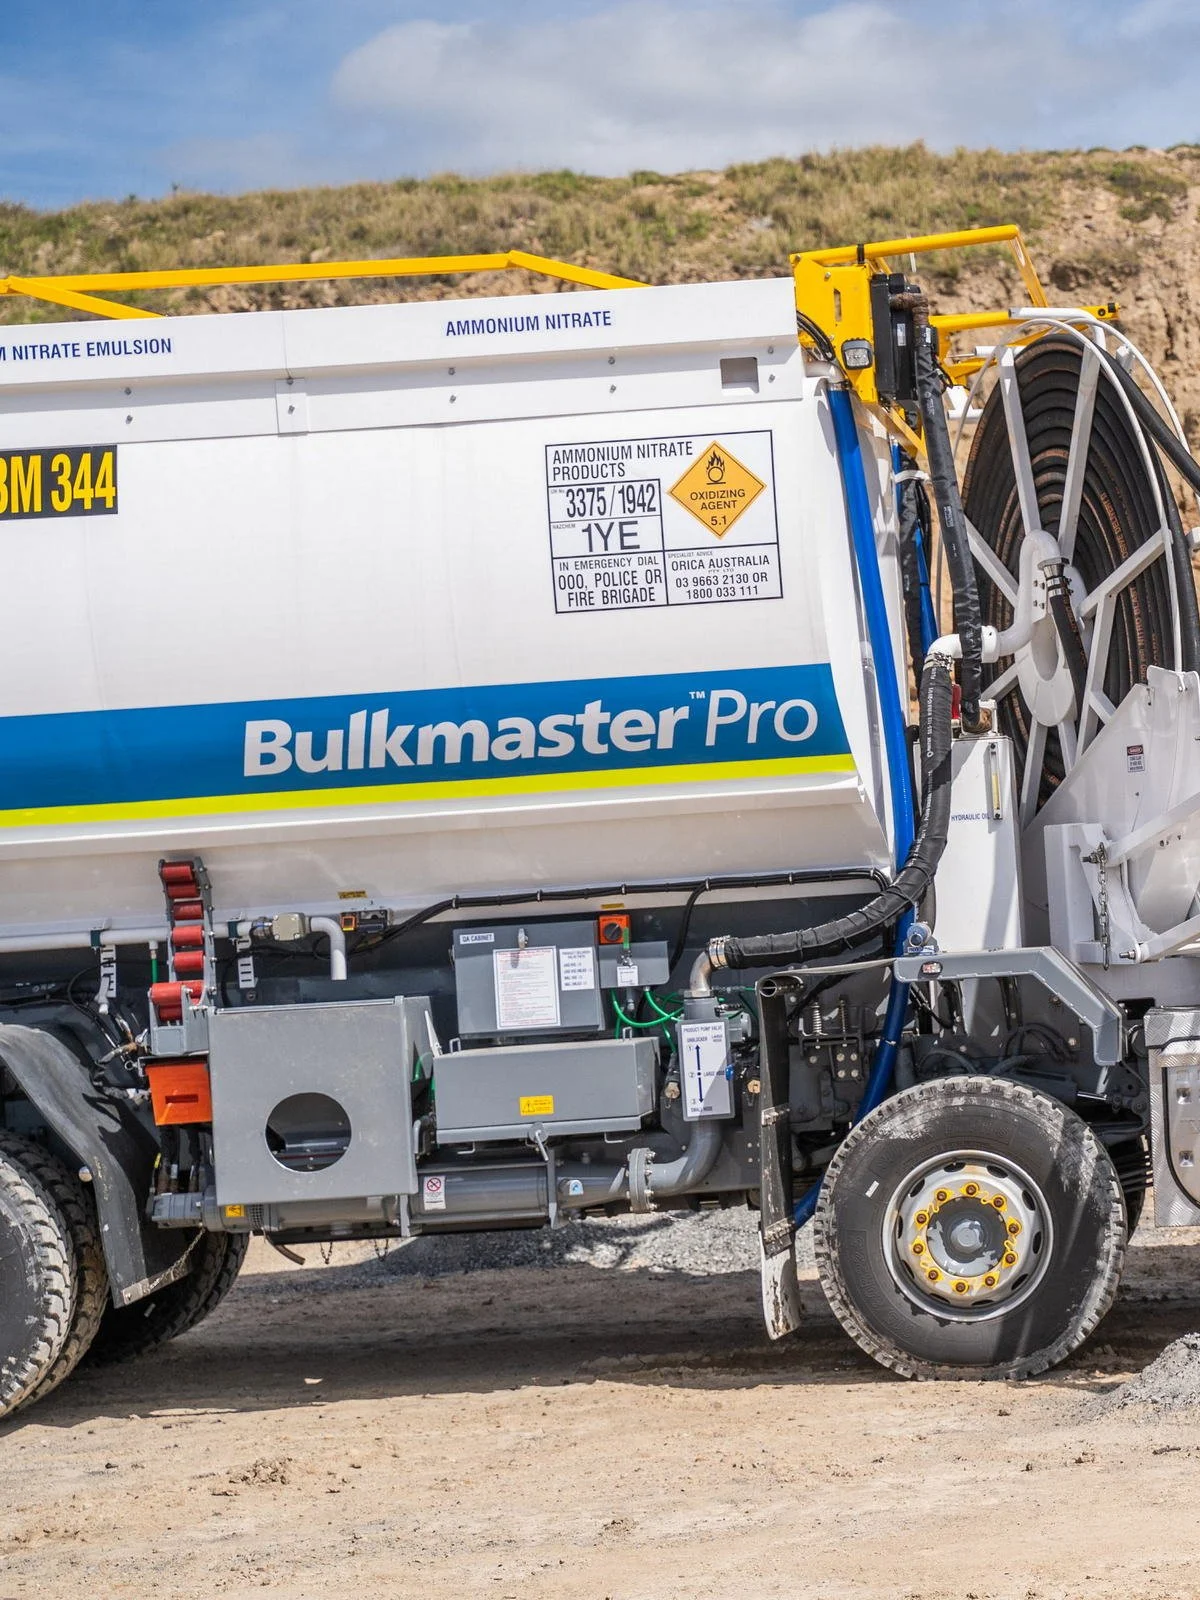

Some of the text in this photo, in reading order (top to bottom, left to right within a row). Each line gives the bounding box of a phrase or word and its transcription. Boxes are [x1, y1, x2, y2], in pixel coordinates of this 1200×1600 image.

[446, 310, 612, 336] AMMONIUM NITRATE
[12, 342, 81, 360] NITRATE
[86, 338, 172, 357] EMULSION
[553, 441, 693, 465] AMMONIUM NITRATE
[552, 462, 626, 481] PRODUCTS
[51, 451, 116, 512] 344
[690, 488, 746, 501] OXIDIZING
[700, 500, 737, 511] AGENT
[711, 515, 728, 526] 5.1
[581, 520, 641, 553] 1YE
[559, 556, 659, 572] IN EMERGENCY DIAL
[671, 555, 770, 571] ORICA AUSTRALIA
[594, 570, 639, 588] POLICE
[645, 568, 663, 584] OR
[675, 572, 768, 588] 03 9663 2130 OR
[568, 587, 656, 607] FIRE BRIGADE
[687, 585, 758, 600] 1800 033 111
[704, 688, 819, 747] Pro
[951, 813, 981, 821] HYDRAULIC
